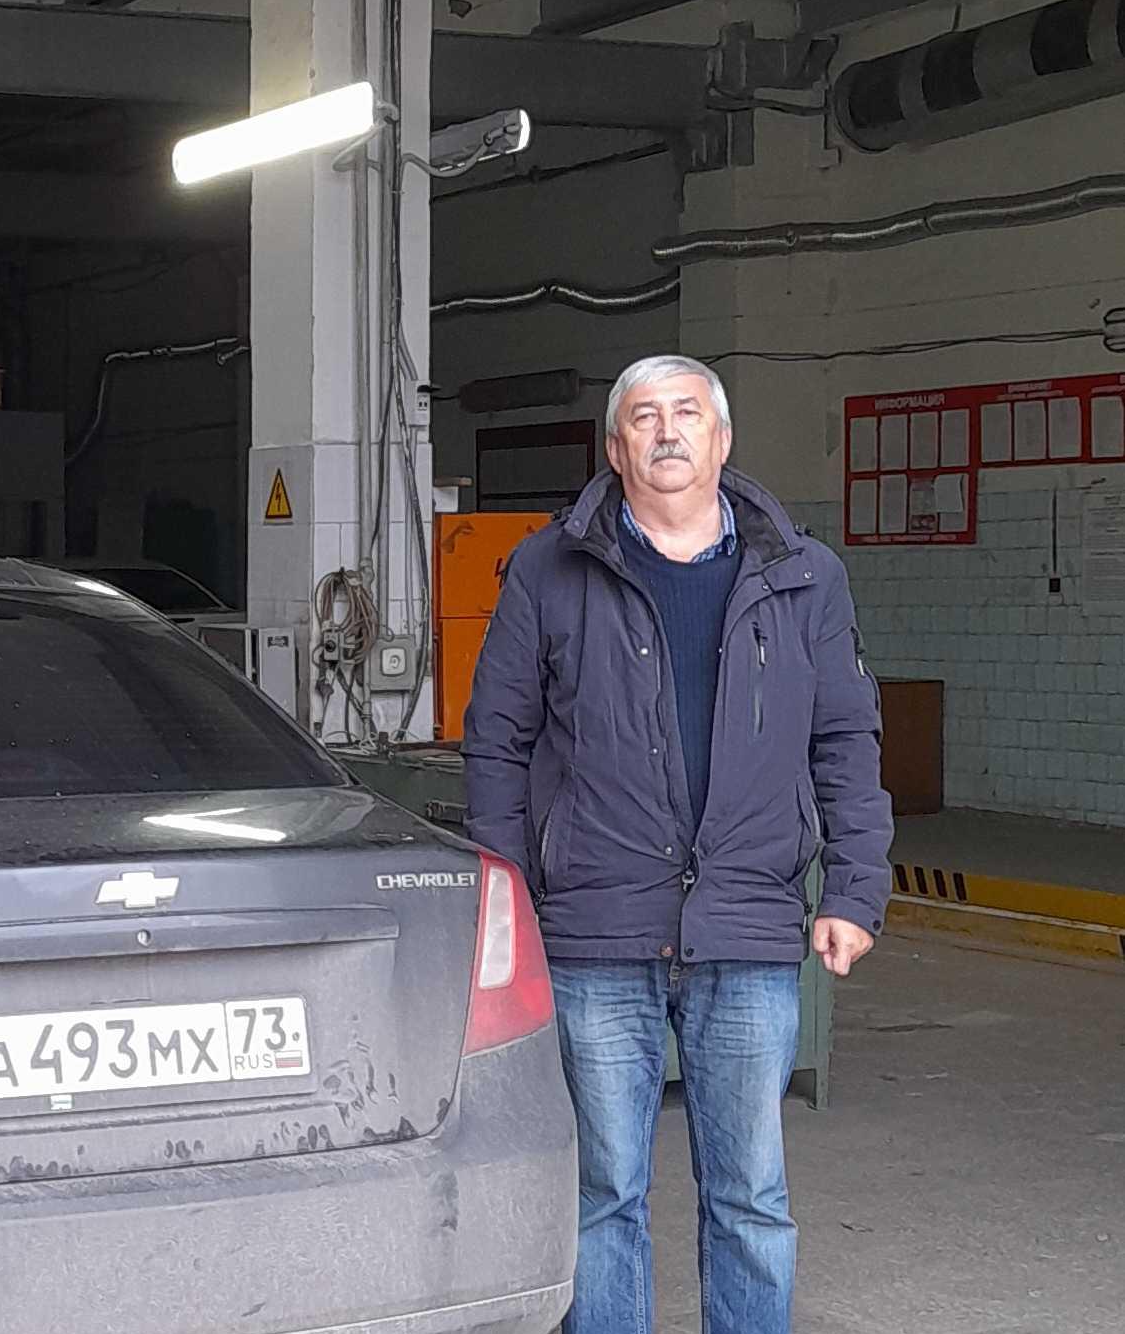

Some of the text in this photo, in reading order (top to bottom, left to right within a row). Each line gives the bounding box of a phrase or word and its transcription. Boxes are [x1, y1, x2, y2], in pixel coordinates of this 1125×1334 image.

[376, 872, 477, 889] CHEVROLET
[233, 1006, 287, 1054] 73
[234, 1053, 274, 1071] RUS
